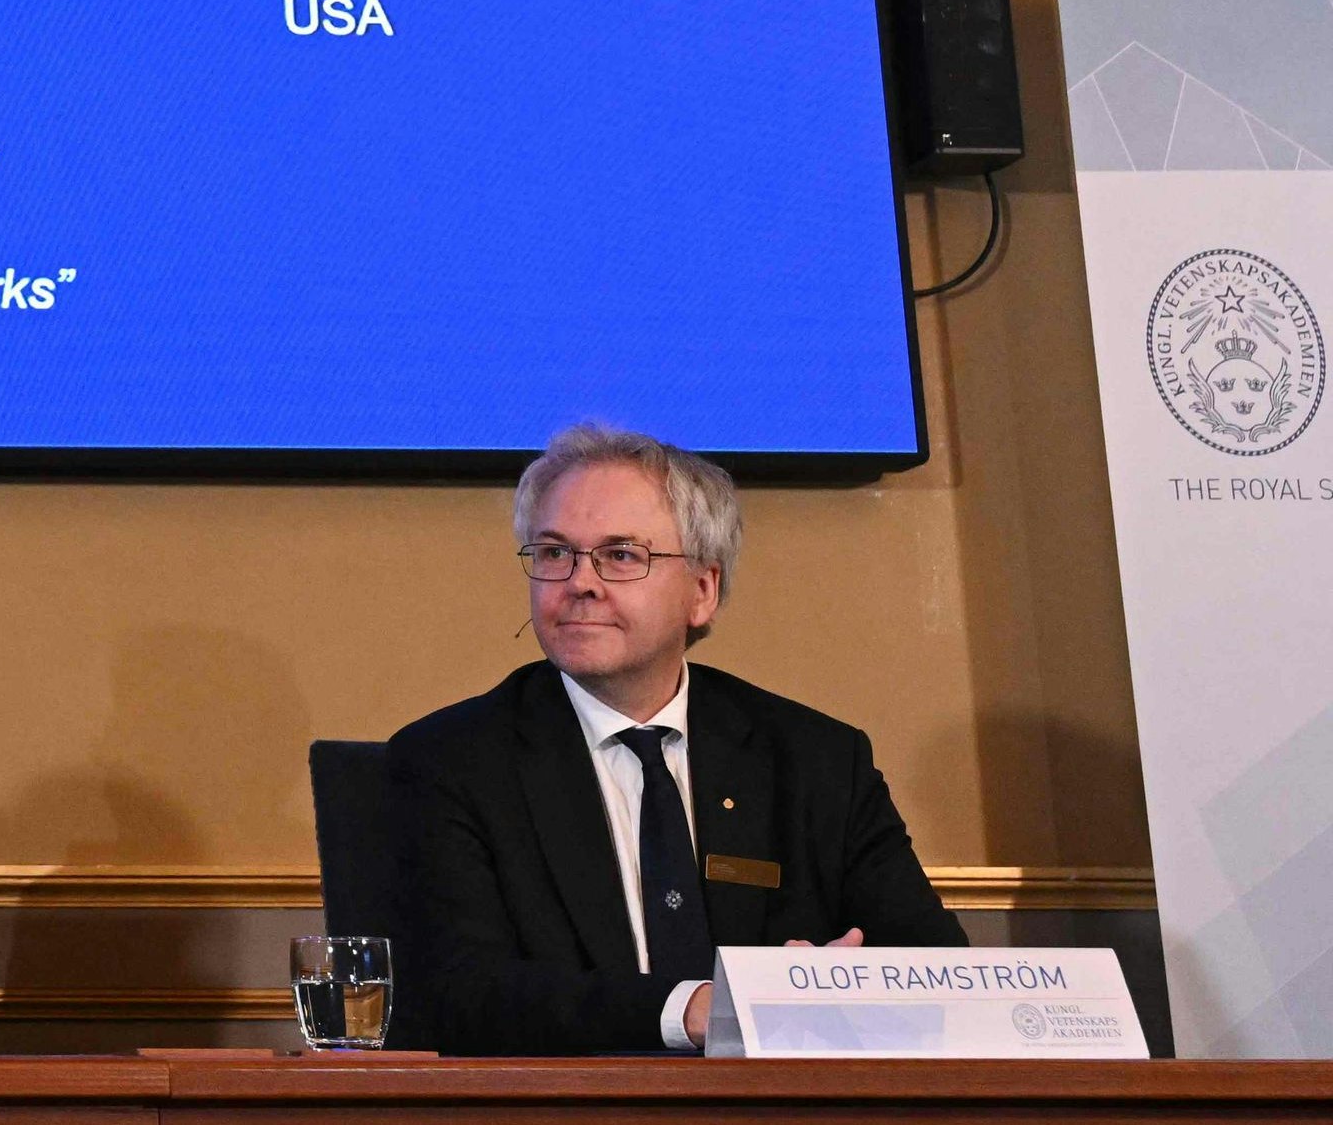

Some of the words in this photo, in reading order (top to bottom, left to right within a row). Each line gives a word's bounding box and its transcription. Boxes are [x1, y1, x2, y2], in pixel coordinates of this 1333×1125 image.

[1160, 258, 1316, 399] VETENSKAPSAKADEMIEN
[1157, 323, 1187, 397] KUNGL.
[1168, 477, 1222, 501] THE
[1230, 477, 1313, 501] ROYAL
[788, 964, 873, 991] OLOF
[881, 959, 1068, 991] RAMSTRÖM
